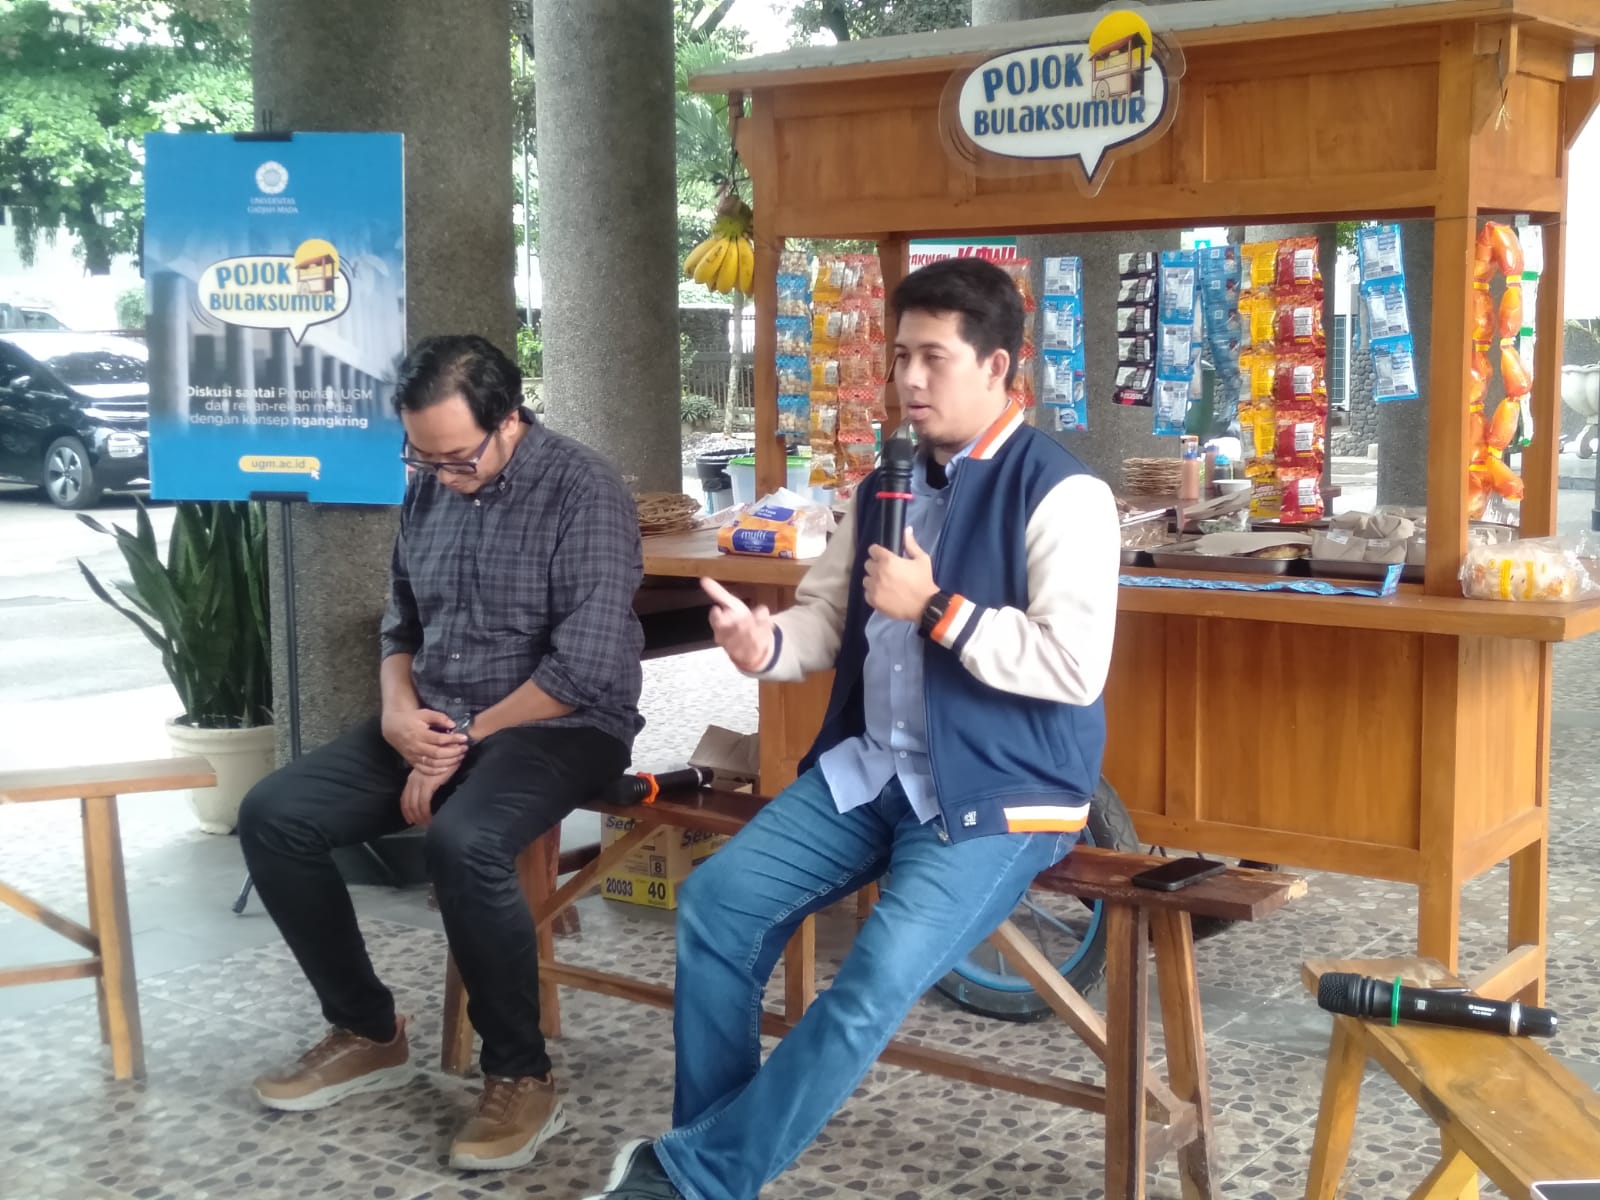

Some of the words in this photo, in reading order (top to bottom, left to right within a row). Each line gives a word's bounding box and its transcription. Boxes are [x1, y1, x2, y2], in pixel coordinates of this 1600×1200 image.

[982, 53, 1084, 103] POJOK
[215, 262, 291, 289] POJOK
[187, 385, 232, 398] Diskusi
[235, 387, 275, 398] santai
[341, 388, 373, 400] UGM
[233, 401, 310, 412] rekan-rekan
[313, 402, 353, 413] media
[190, 413, 239, 427] dengan
[242, 414, 289, 428] konsep
[292, 415, 368, 429] ngangkring
[251, 458, 305, 470] ugm.ac.id
[740, 530, 768, 541] multi
[606, 878, 633, 897] 20033
[648, 881, 666, 900] 40
